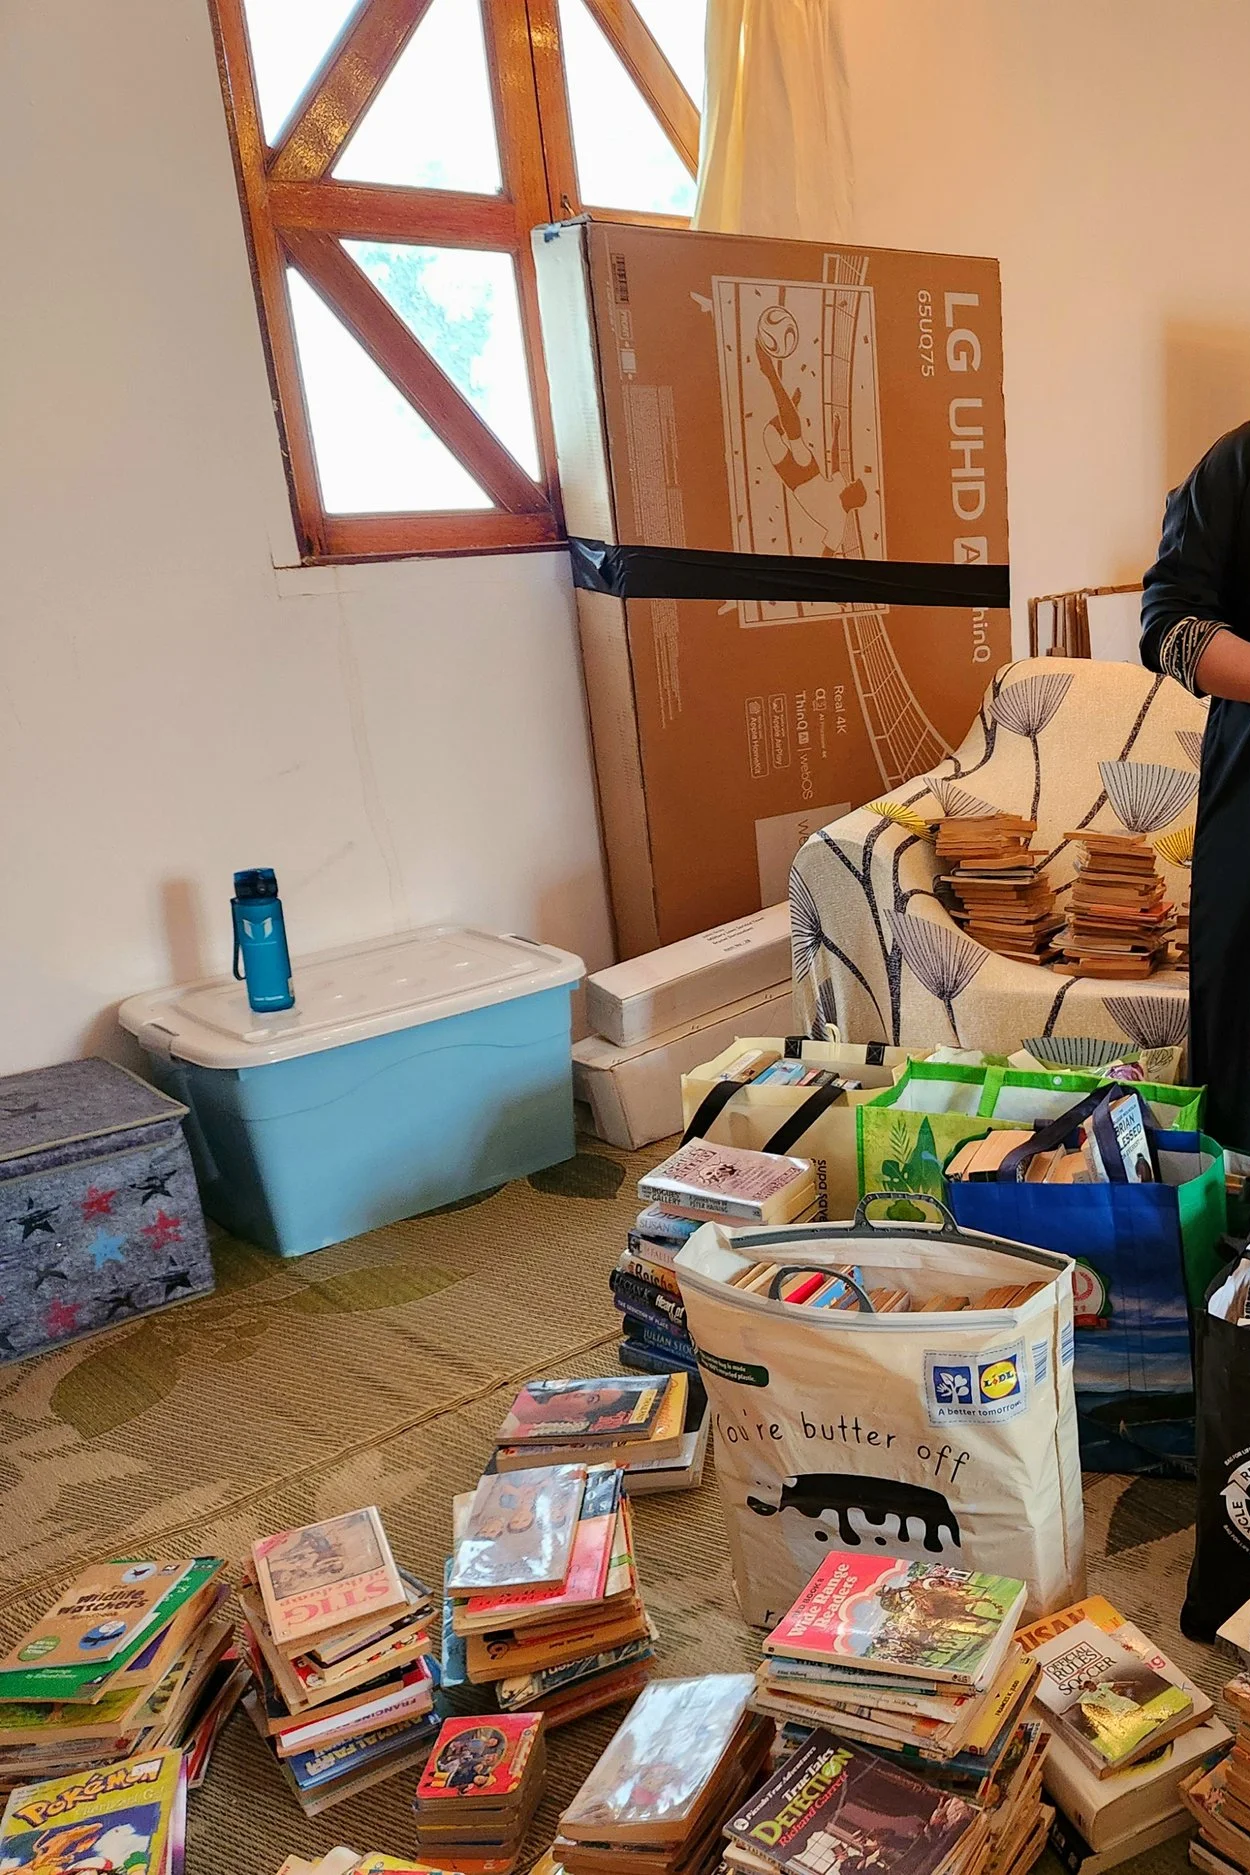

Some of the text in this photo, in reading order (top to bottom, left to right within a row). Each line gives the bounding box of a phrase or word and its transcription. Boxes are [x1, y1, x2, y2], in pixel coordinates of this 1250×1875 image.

[917, 289, 934, 377] 65UQ75
[945, 291, 991, 664] LG UHD hinQ
[834, 686, 846, 734] Real 4K
[795, 690, 813, 799] ThinQ webOS
[818, 1159, 827, 1191] supa
[640, 1219, 671, 1232] SUSAN
[938, 1408, 945, 1416] A
[948, 1408, 975, 1416] better
[800, 1411, 898, 1449] butter
[917, 1445, 970, 1483] off
[57, 1599, 150, 1616] Watchers
[77, 1588, 146, 1605] Wildlife
[283, 1578, 390, 1627] STIG
[786, 1605, 821, 1636] Wide
[812, 1563, 849, 1605] Range
[812, 1576, 858, 1629] Readers
[1046, 1645, 1090, 1673] OFFICIAL
[1052, 1651, 1098, 1680] RULES
[1058, 1656, 1117, 1696] SOCCER
[805, 1747, 834, 1776] Tales
[779, 1808, 816, 1847] Richard
